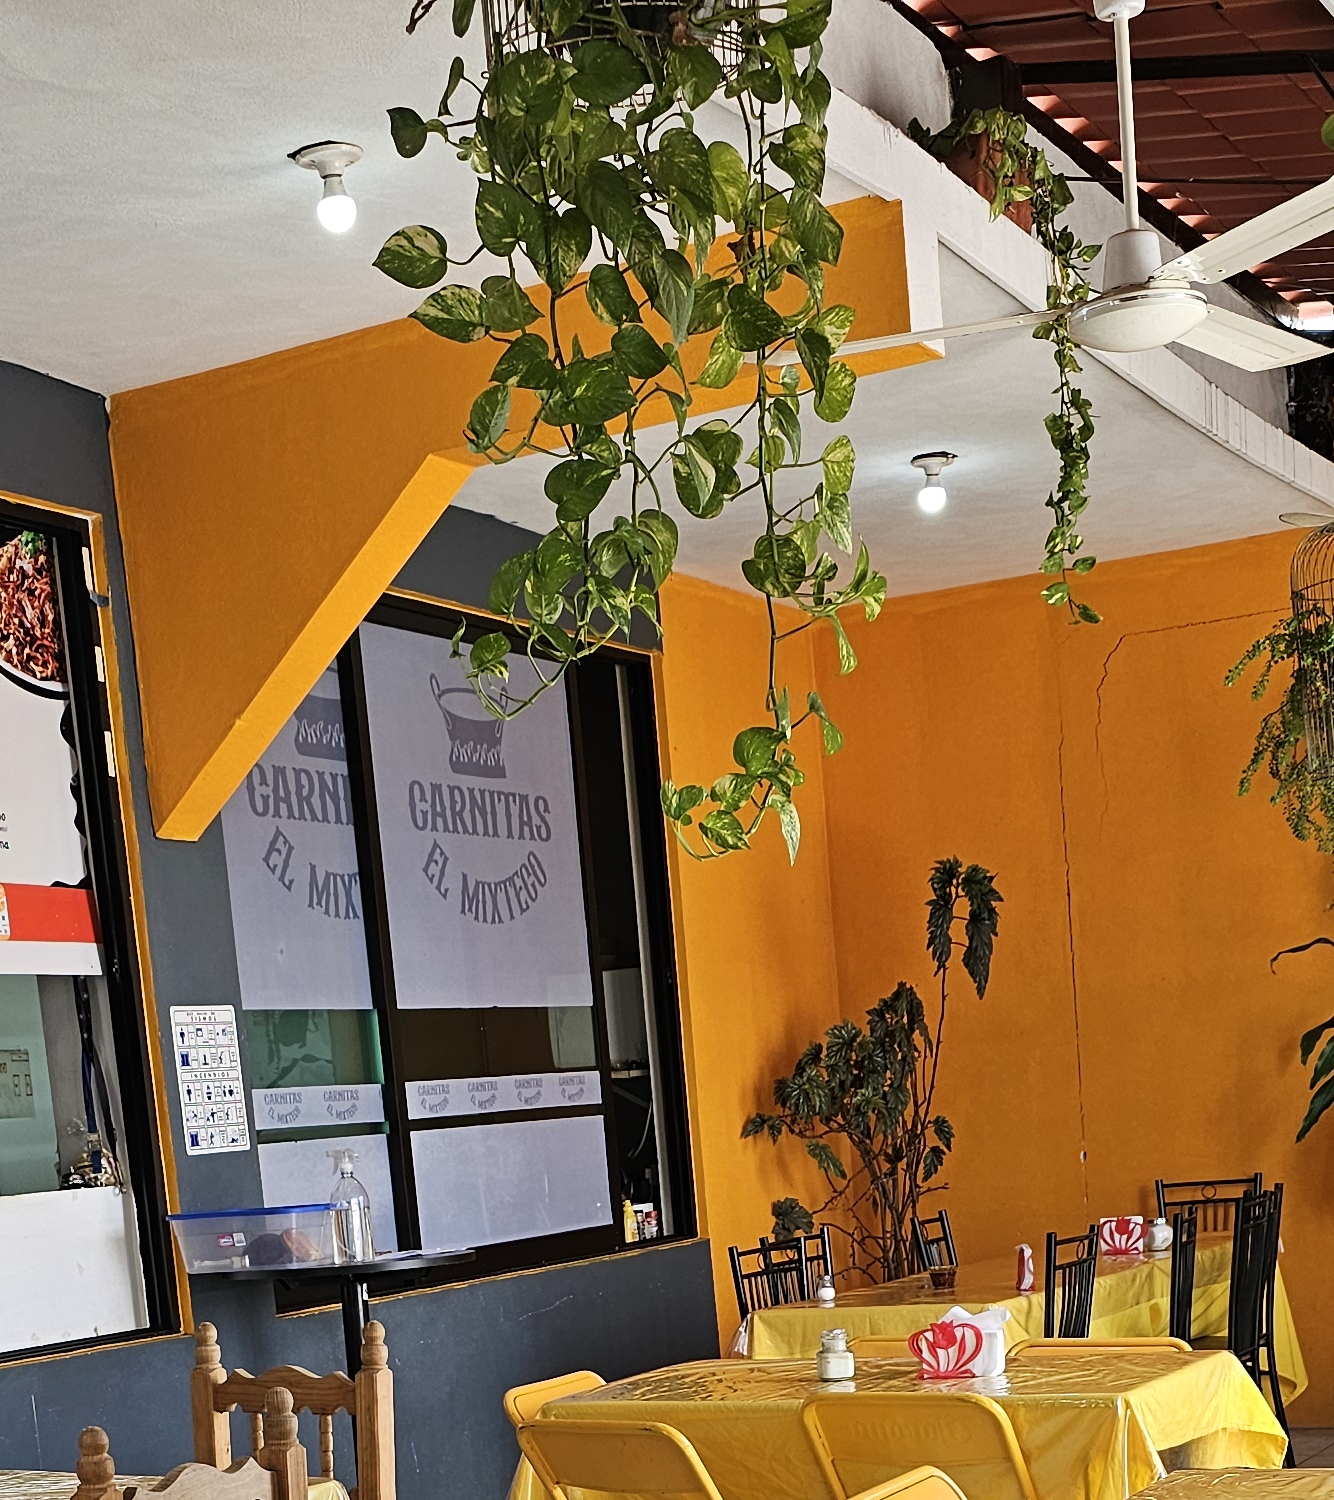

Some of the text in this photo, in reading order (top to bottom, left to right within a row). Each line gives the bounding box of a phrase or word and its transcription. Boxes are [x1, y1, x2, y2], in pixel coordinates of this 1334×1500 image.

[408, 780, 552, 842] CARNITAS
[262, 825, 294, 892] EL
[422, 838, 547, 925] EL MIXTECO
[264, 1092, 303, 1106] CARNITAS
[323, 1089, 360, 1103] CARNITAS
[417, 1084, 450, 1096] CARNITAS
